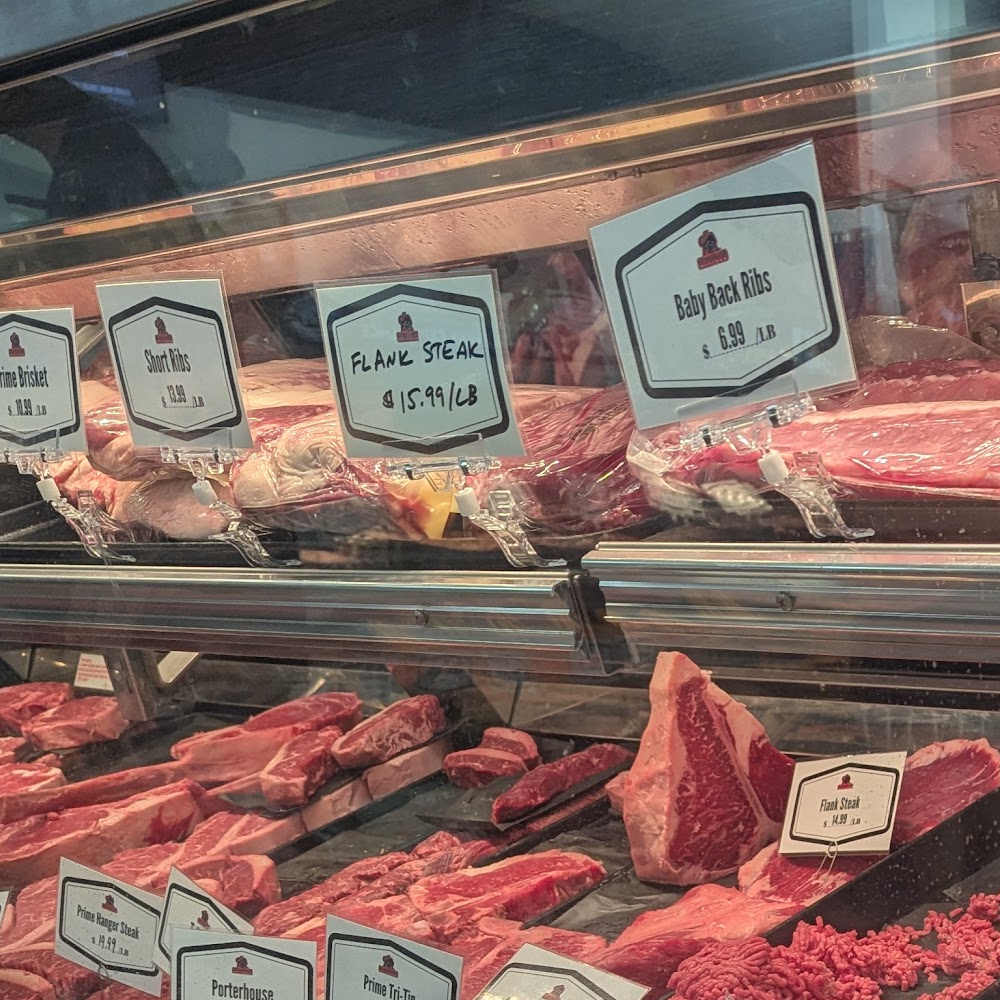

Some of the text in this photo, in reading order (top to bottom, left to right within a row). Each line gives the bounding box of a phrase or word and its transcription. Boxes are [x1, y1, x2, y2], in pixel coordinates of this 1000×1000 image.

[674, 268, 773, 321] Baby Back Ribs
[718, 320, 746, 351] 6.99
[755, 324, 777, 345] /LB
[144, 348, 191, 374] Short Ribs
[350, 339, 485, 375] FLANK STEAK
[0, 365, 49, 389] rime Brisket
[15, 398, 33, 416] 10.99
[166, 385, 187, 405] 13.99
[819, 796, 861, 813] Flank Steak
[76, 904, 140, 940] Prime Hanger Steak
[363, 974, 387, 997] Prime
